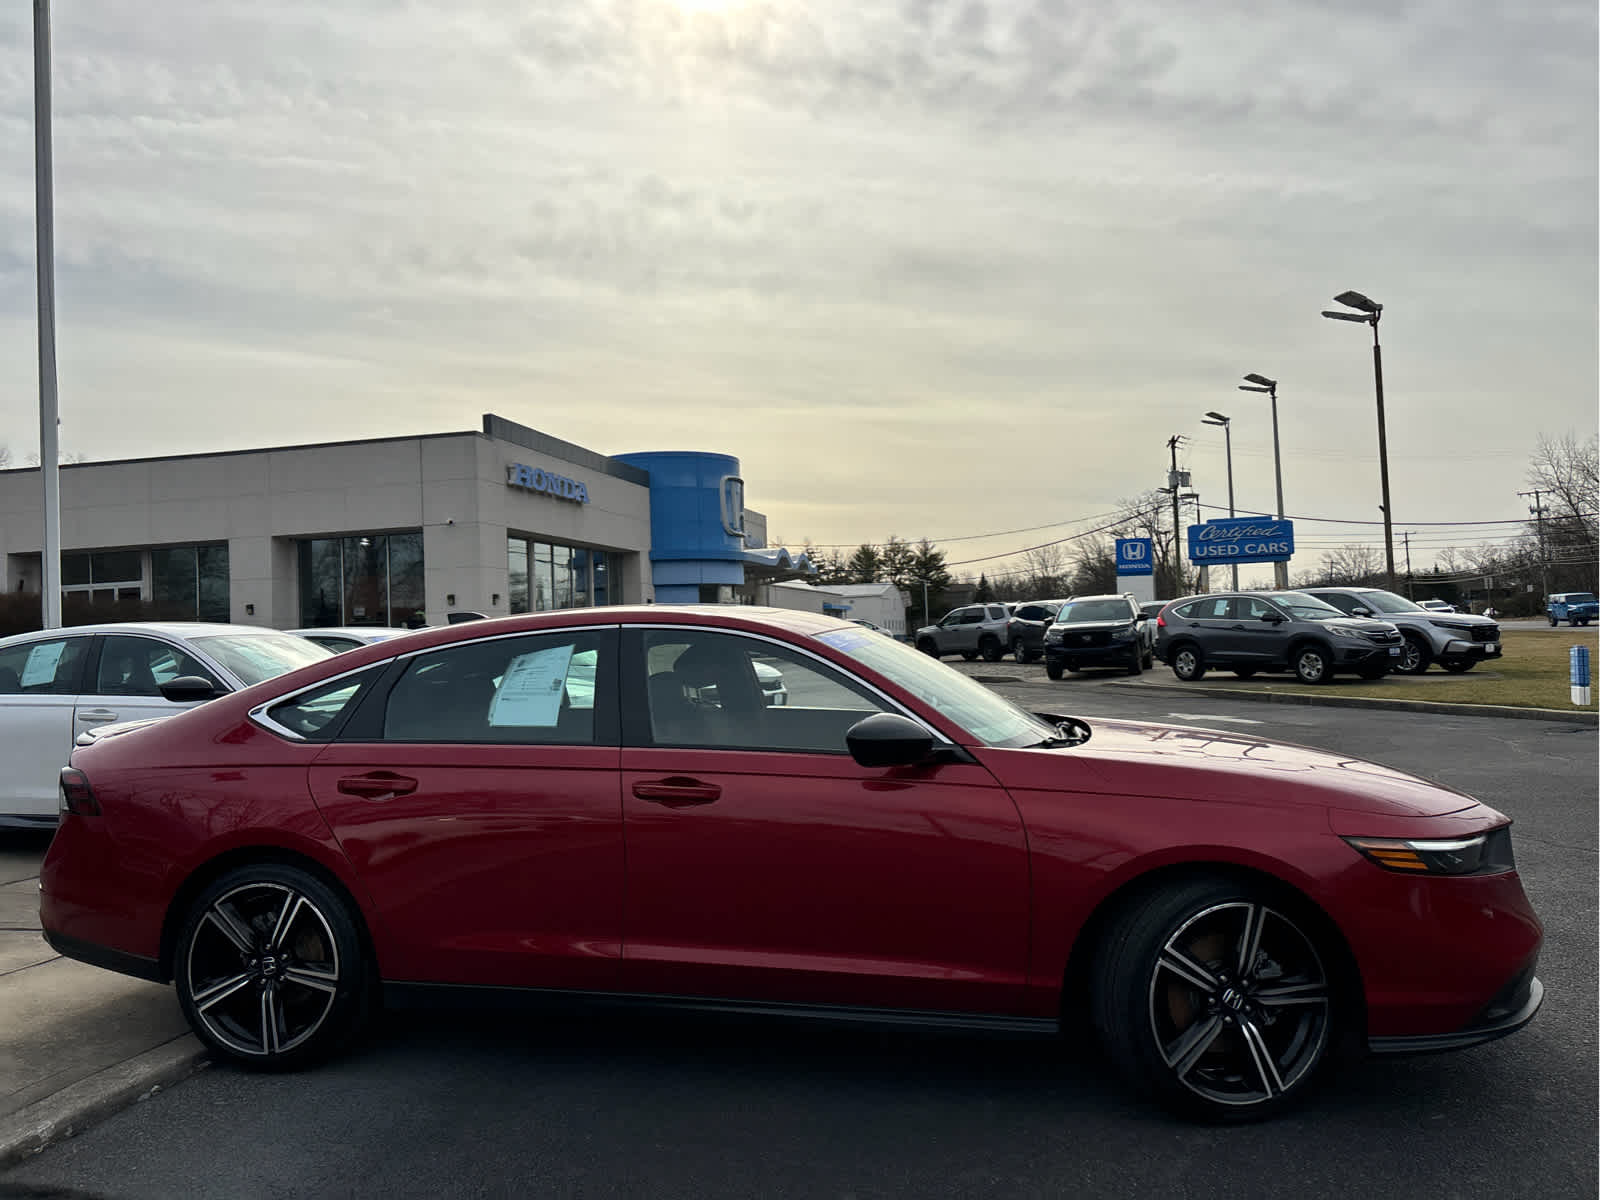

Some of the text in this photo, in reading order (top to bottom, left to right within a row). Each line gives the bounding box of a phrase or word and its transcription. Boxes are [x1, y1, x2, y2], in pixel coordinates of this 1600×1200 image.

[506, 463, 590, 504] HONDA
[1199, 525, 1283, 543] Certified
[1195, 541, 1289, 557] USED CARS
